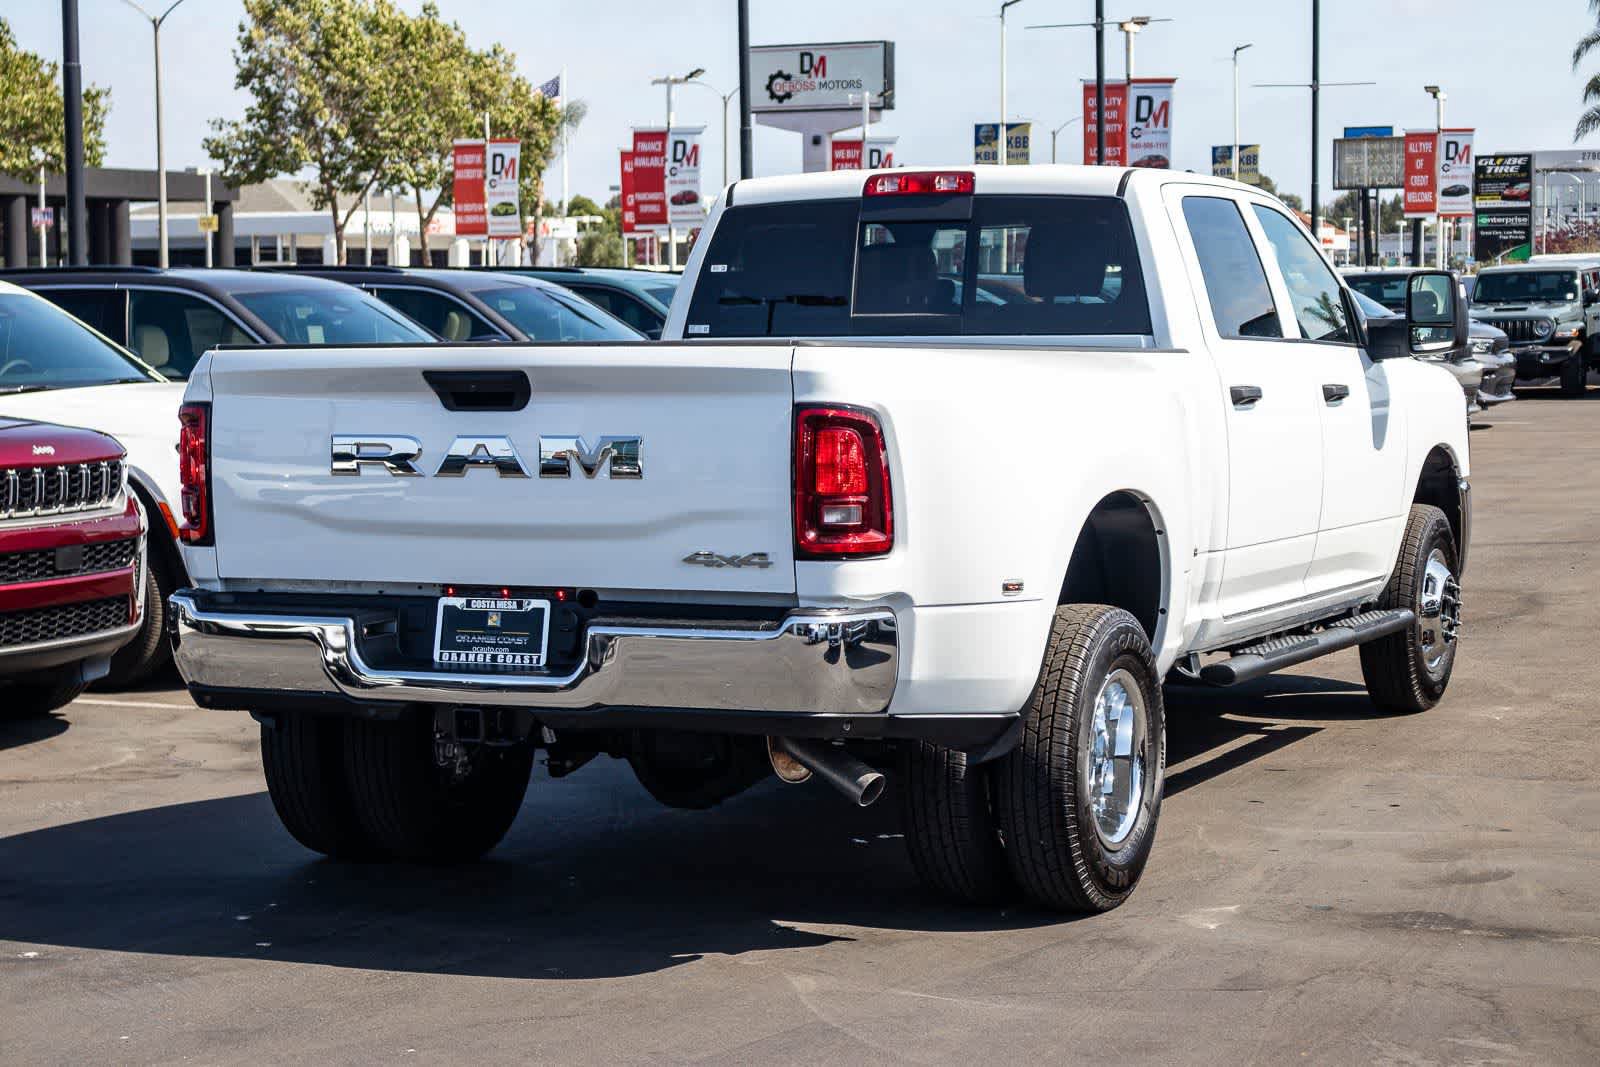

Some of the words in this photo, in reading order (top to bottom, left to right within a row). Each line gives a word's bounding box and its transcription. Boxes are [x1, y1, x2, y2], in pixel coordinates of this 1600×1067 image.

[800, 52, 827, 78] DM
[818, 79, 862, 90] MOTORS
[1136, 95, 1169, 128] DM
[1006, 136, 1029, 149] KBB
[1408, 142, 1420, 153] ALL
[1420, 142, 1433, 152] TYPE
[834, 149, 847, 159] WE
[976, 151, 998, 161] KBB
[1446, 141, 1470, 165] DM
[1239, 154, 1258, 166] KBB
[1416, 159, 1424, 169] OF
[1486, 165, 1520, 174] TIRE
[1410, 175, 1429, 186] CREDIT
[1407, 192, 1433, 203] WELCOME
[1478, 216, 1528, 225] enterprise
[331, 434, 644, 480] RAM
[681, 551, 776, 569] 4x4
[470, 599, 496, 609] COSTA
[497, 600, 518, 609] MESA
[455, 634, 496, 643] ORANGE
[497, 635, 529, 645] COAST
[471, 645, 510, 654] ocauto.com
[441, 652, 492, 662] ORANGE
[497, 653, 539, 664] COAST
